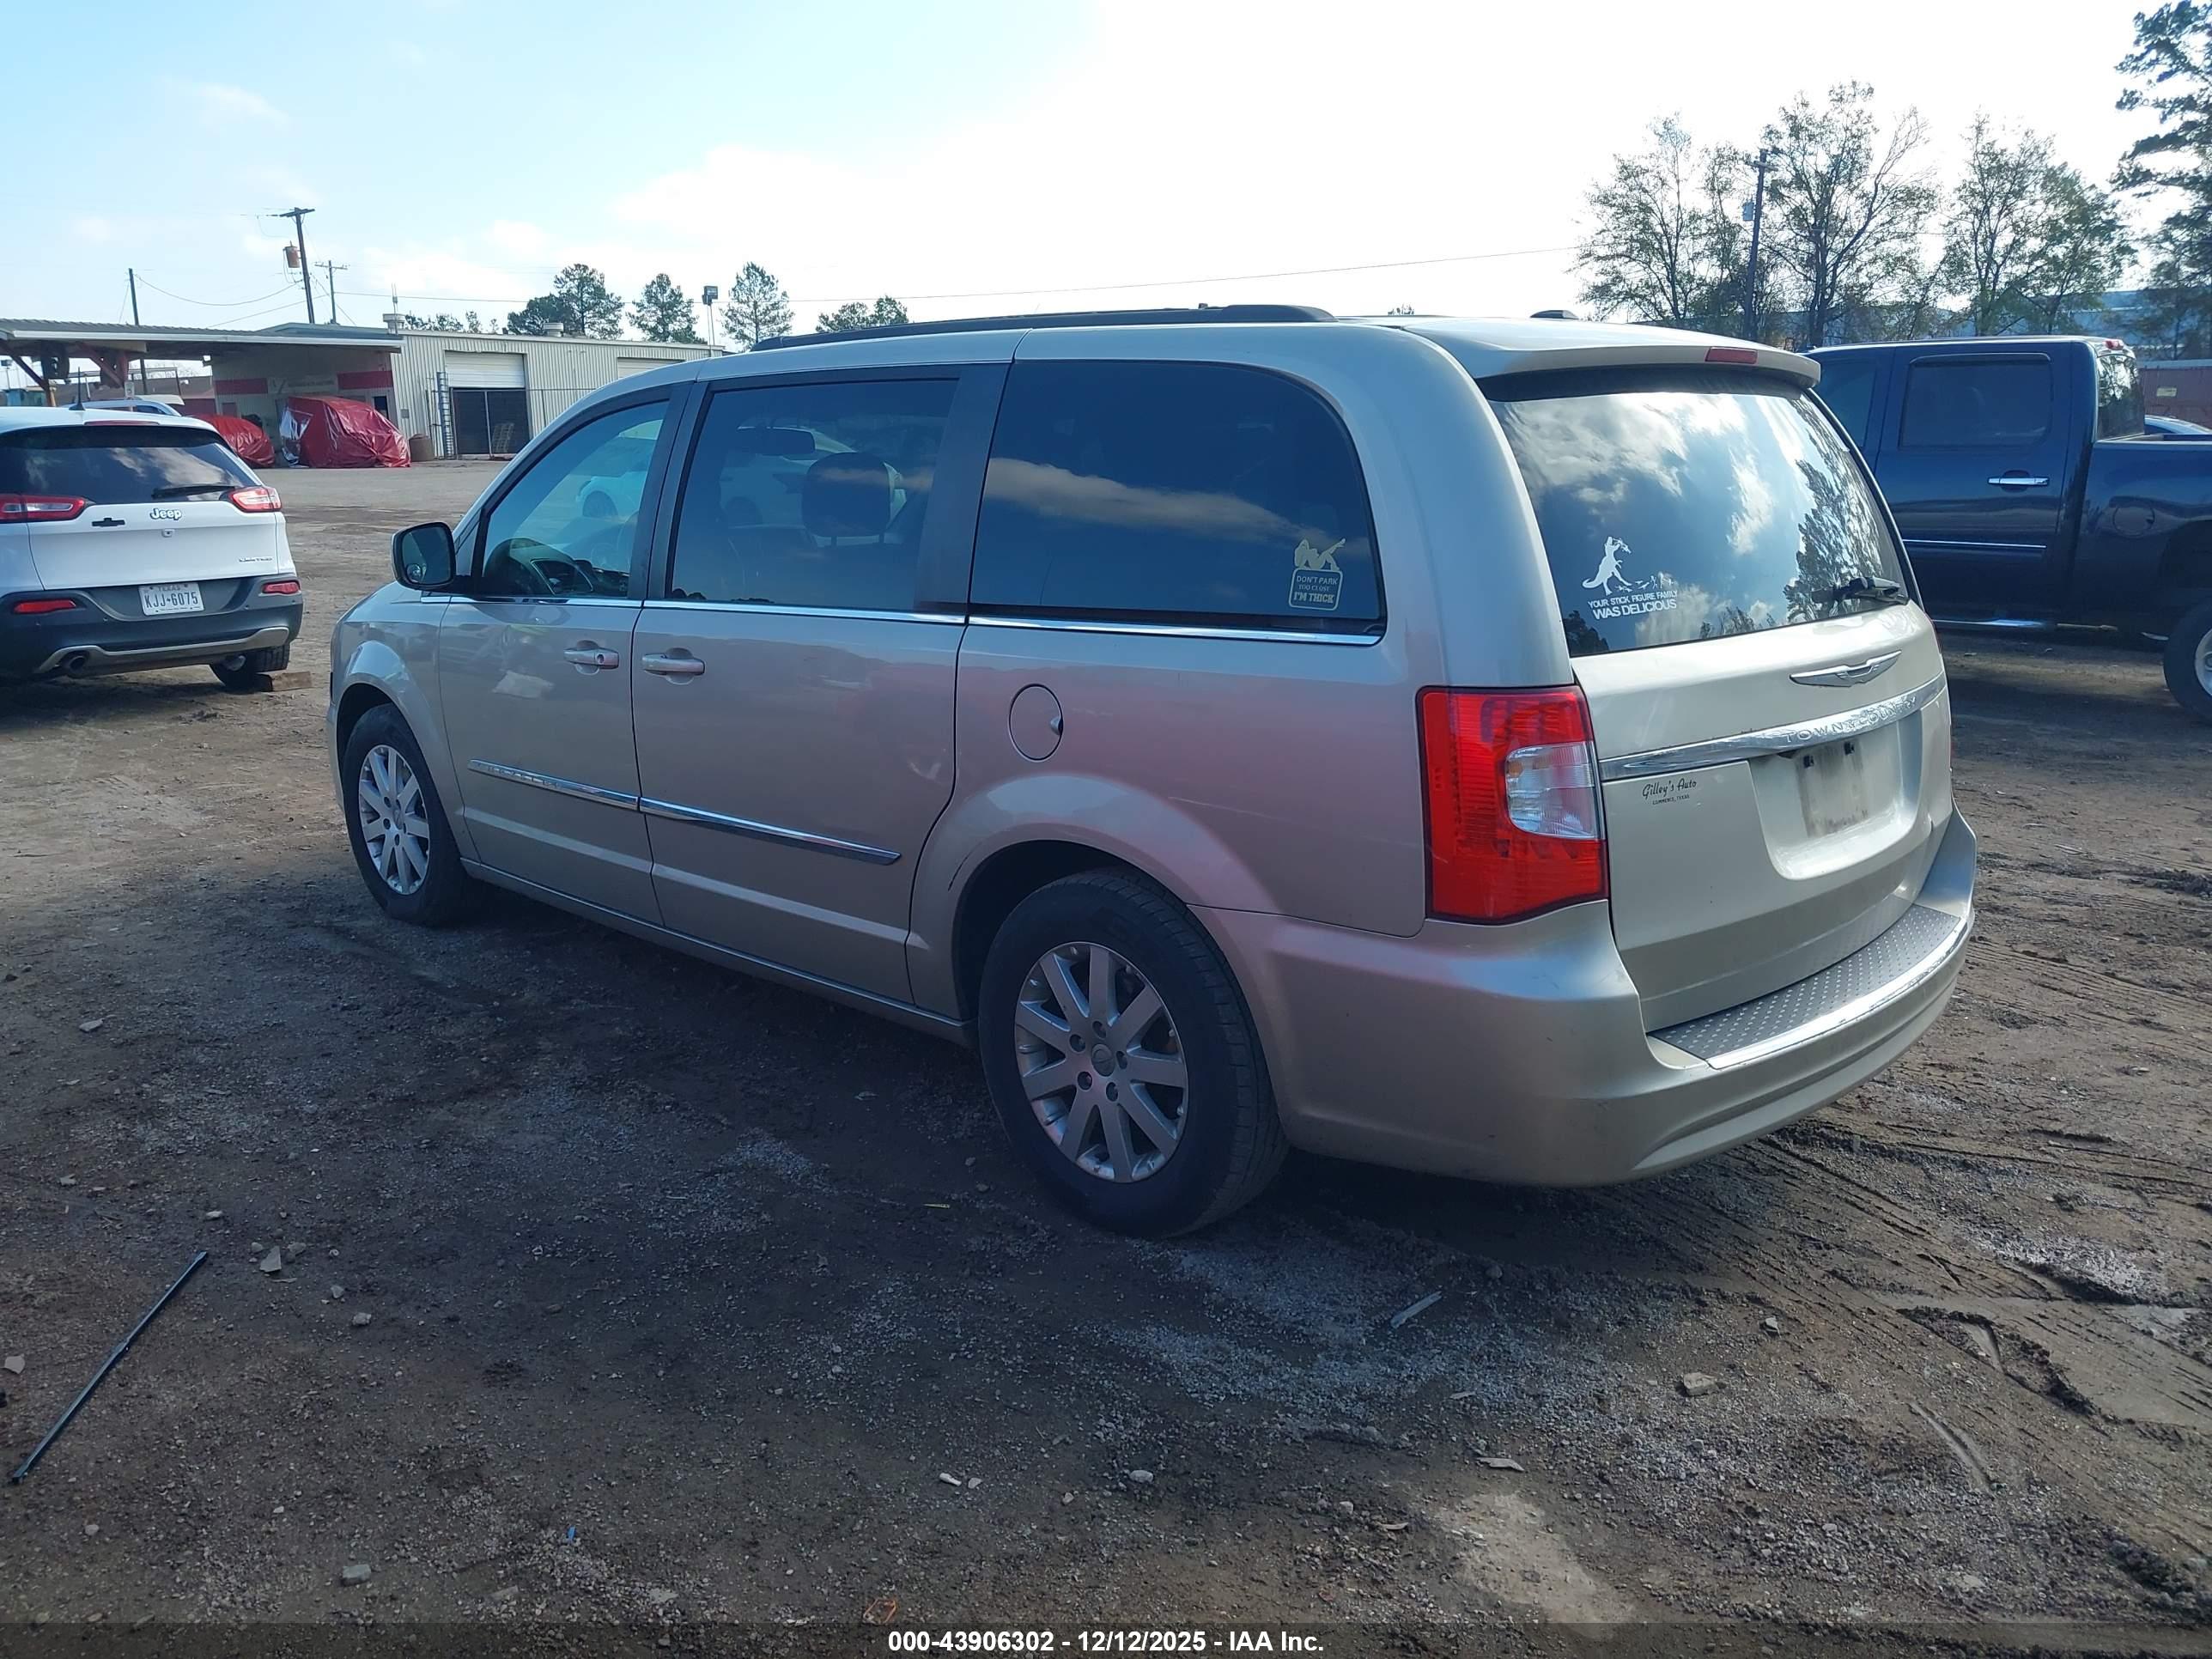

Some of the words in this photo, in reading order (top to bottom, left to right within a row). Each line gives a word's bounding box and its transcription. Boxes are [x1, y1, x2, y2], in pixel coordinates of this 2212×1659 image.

[149, 507, 182, 520] Jeep
[1293, 592, 1308, 601] I'M
[1308, 592, 1334, 604] THICK
[1588, 599, 1609, 609] YOUR
[1610, 595, 1631, 605] STICK
[1632, 592, 1656, 602] FIGURE
[1656, 590, 1677, 599] FAMILY
[1592, 605, 1621, 619] WAS
[1622, 599, 1677, 616] DELICIOUS
[1781, 722, 1844, 743] TOWN
[1642, 780, 1674, 799] Gilley's
[1677, 777, 1697, 790] Auto
